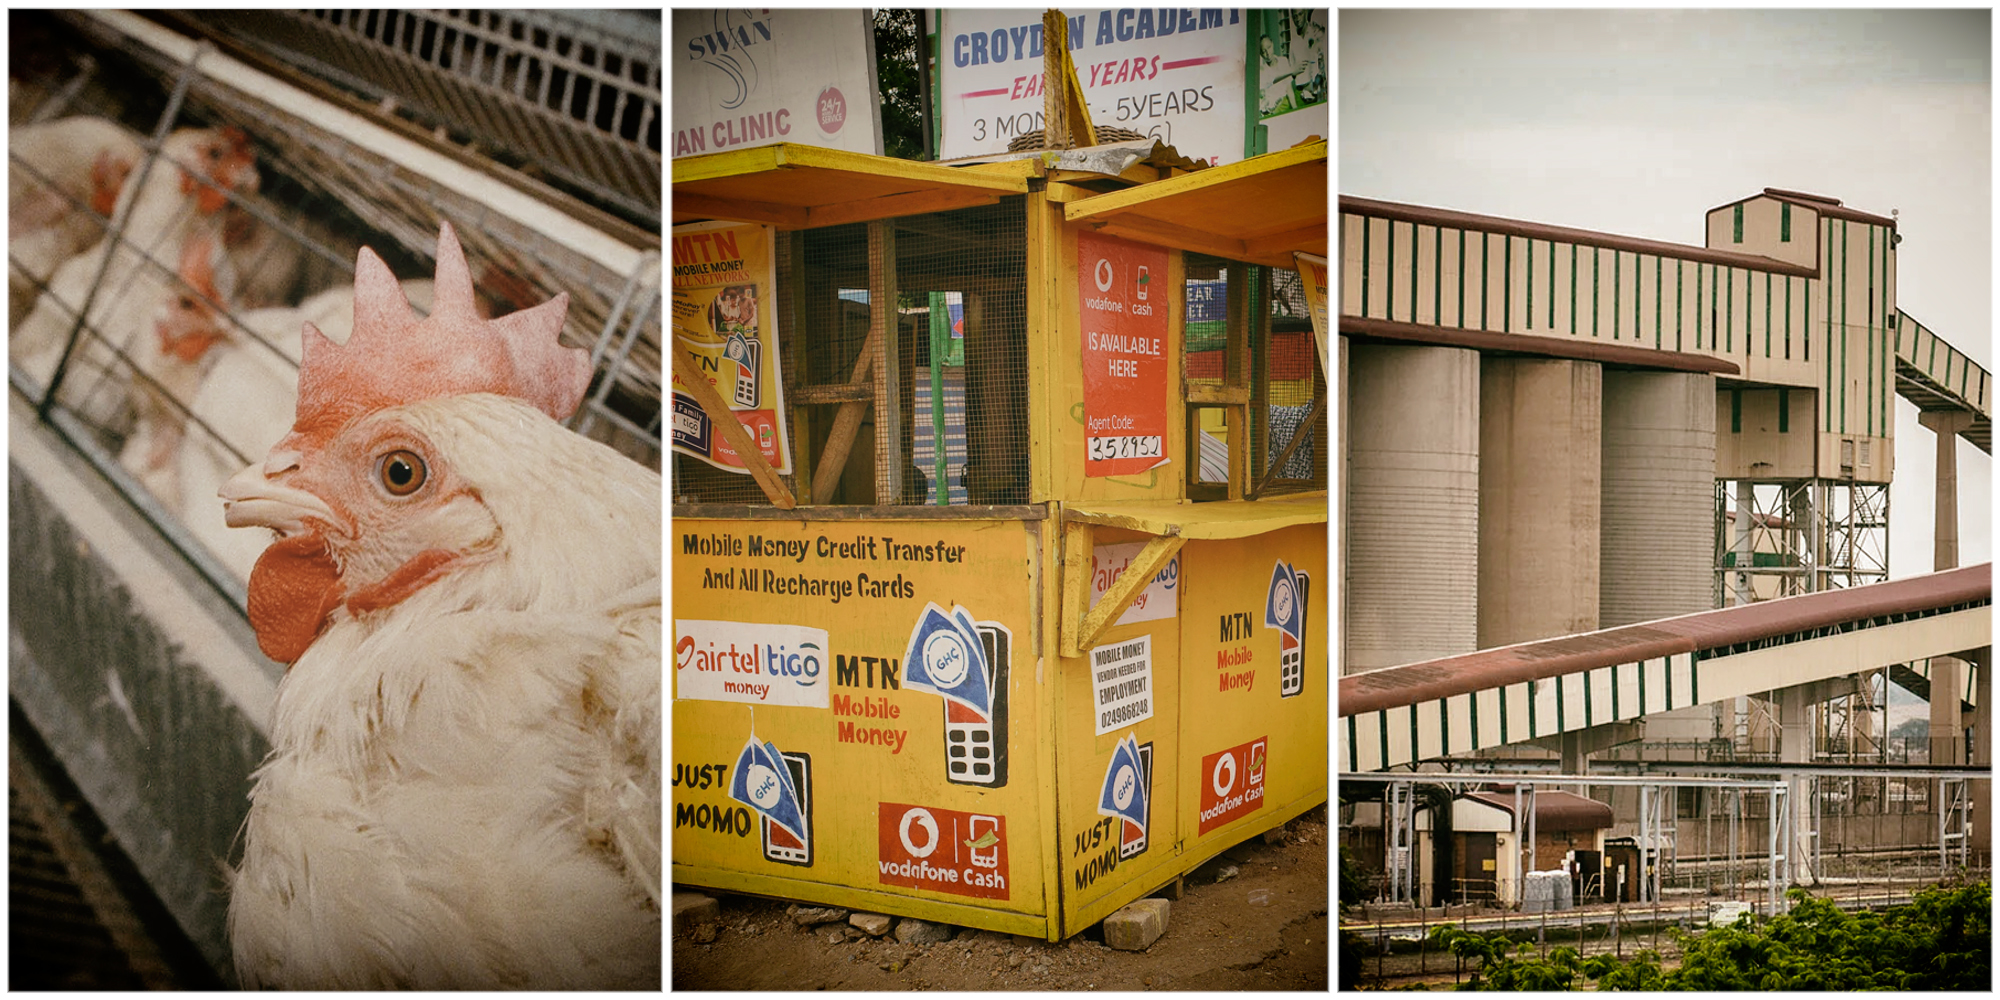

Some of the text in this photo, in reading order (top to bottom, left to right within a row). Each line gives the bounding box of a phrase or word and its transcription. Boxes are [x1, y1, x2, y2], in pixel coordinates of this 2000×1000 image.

[688, 18, 773, 61] SWAN
[954, 15, 1085, 68] CROYDN
[1089, 55, 1161, 88] YEARS
[821, 97, 841, 114] 24/7
[822, 113, 842, 125] SERVICE
[973, 119, 987, 142] 3
[1116, 86, 1214, 121] 5YEARS
[672, 108, 791, 157] AN CLINIC
[672, 231, 740, 265] MTN
[674, 259, 745, 276] MOBILE MONEY
[694, 270, 750, 286] NETWORKS
[1085, 296, 1153, 316] vodafone cash
[1088, 332, 1160, 355] IS AVAILABLE
[688, 350, 719, 373] TN
[1108, 359, 1138, 377] HERE
[683, 417, 699, 434] tigo
[1087, 414, 1135, 434] Agent Code:
[1093, 435, 1159, 461] 358952
[683, 533, 742, 557] Mobile
[748, 534, 810, 563] Money
[816, 535, 878, 561] Credit
[882, 537, 966, 564] Transfer
[703, 567, 914, 603] And All Recharge Cards
[1220, 611, 1252, 643] MTN
[696, 641, 820, 686] airtel tigo
[1095, 641, 1145, 667] MOBILE MONEY
[1217, 645, 1252, 669] Mobile
[836, 654, 900, 690] MTN
[1096, 660, 1146, 683] VENDOR NEEDED FOR
[1219, 669, 1255, 692] Money
[724, 680, 770, 700] money
[1099, 676, 1147, 705] EMPLOYMENT
[833, 694, 901, 719] Mobile
[1101, 698, 1148, 729] 0249868248
[838, 721, 908, 755] Money
[672, 763, 727, 790] JUST
[1200, 782, 1264, 823] vodafone Cash
[676, 802, 752, 838] MOMO
[1073, 816, 1113, 858] JUST
[878, 859, 1005, 889] vodafone Cash
[1075, 845, 1117, 891] MOMO
